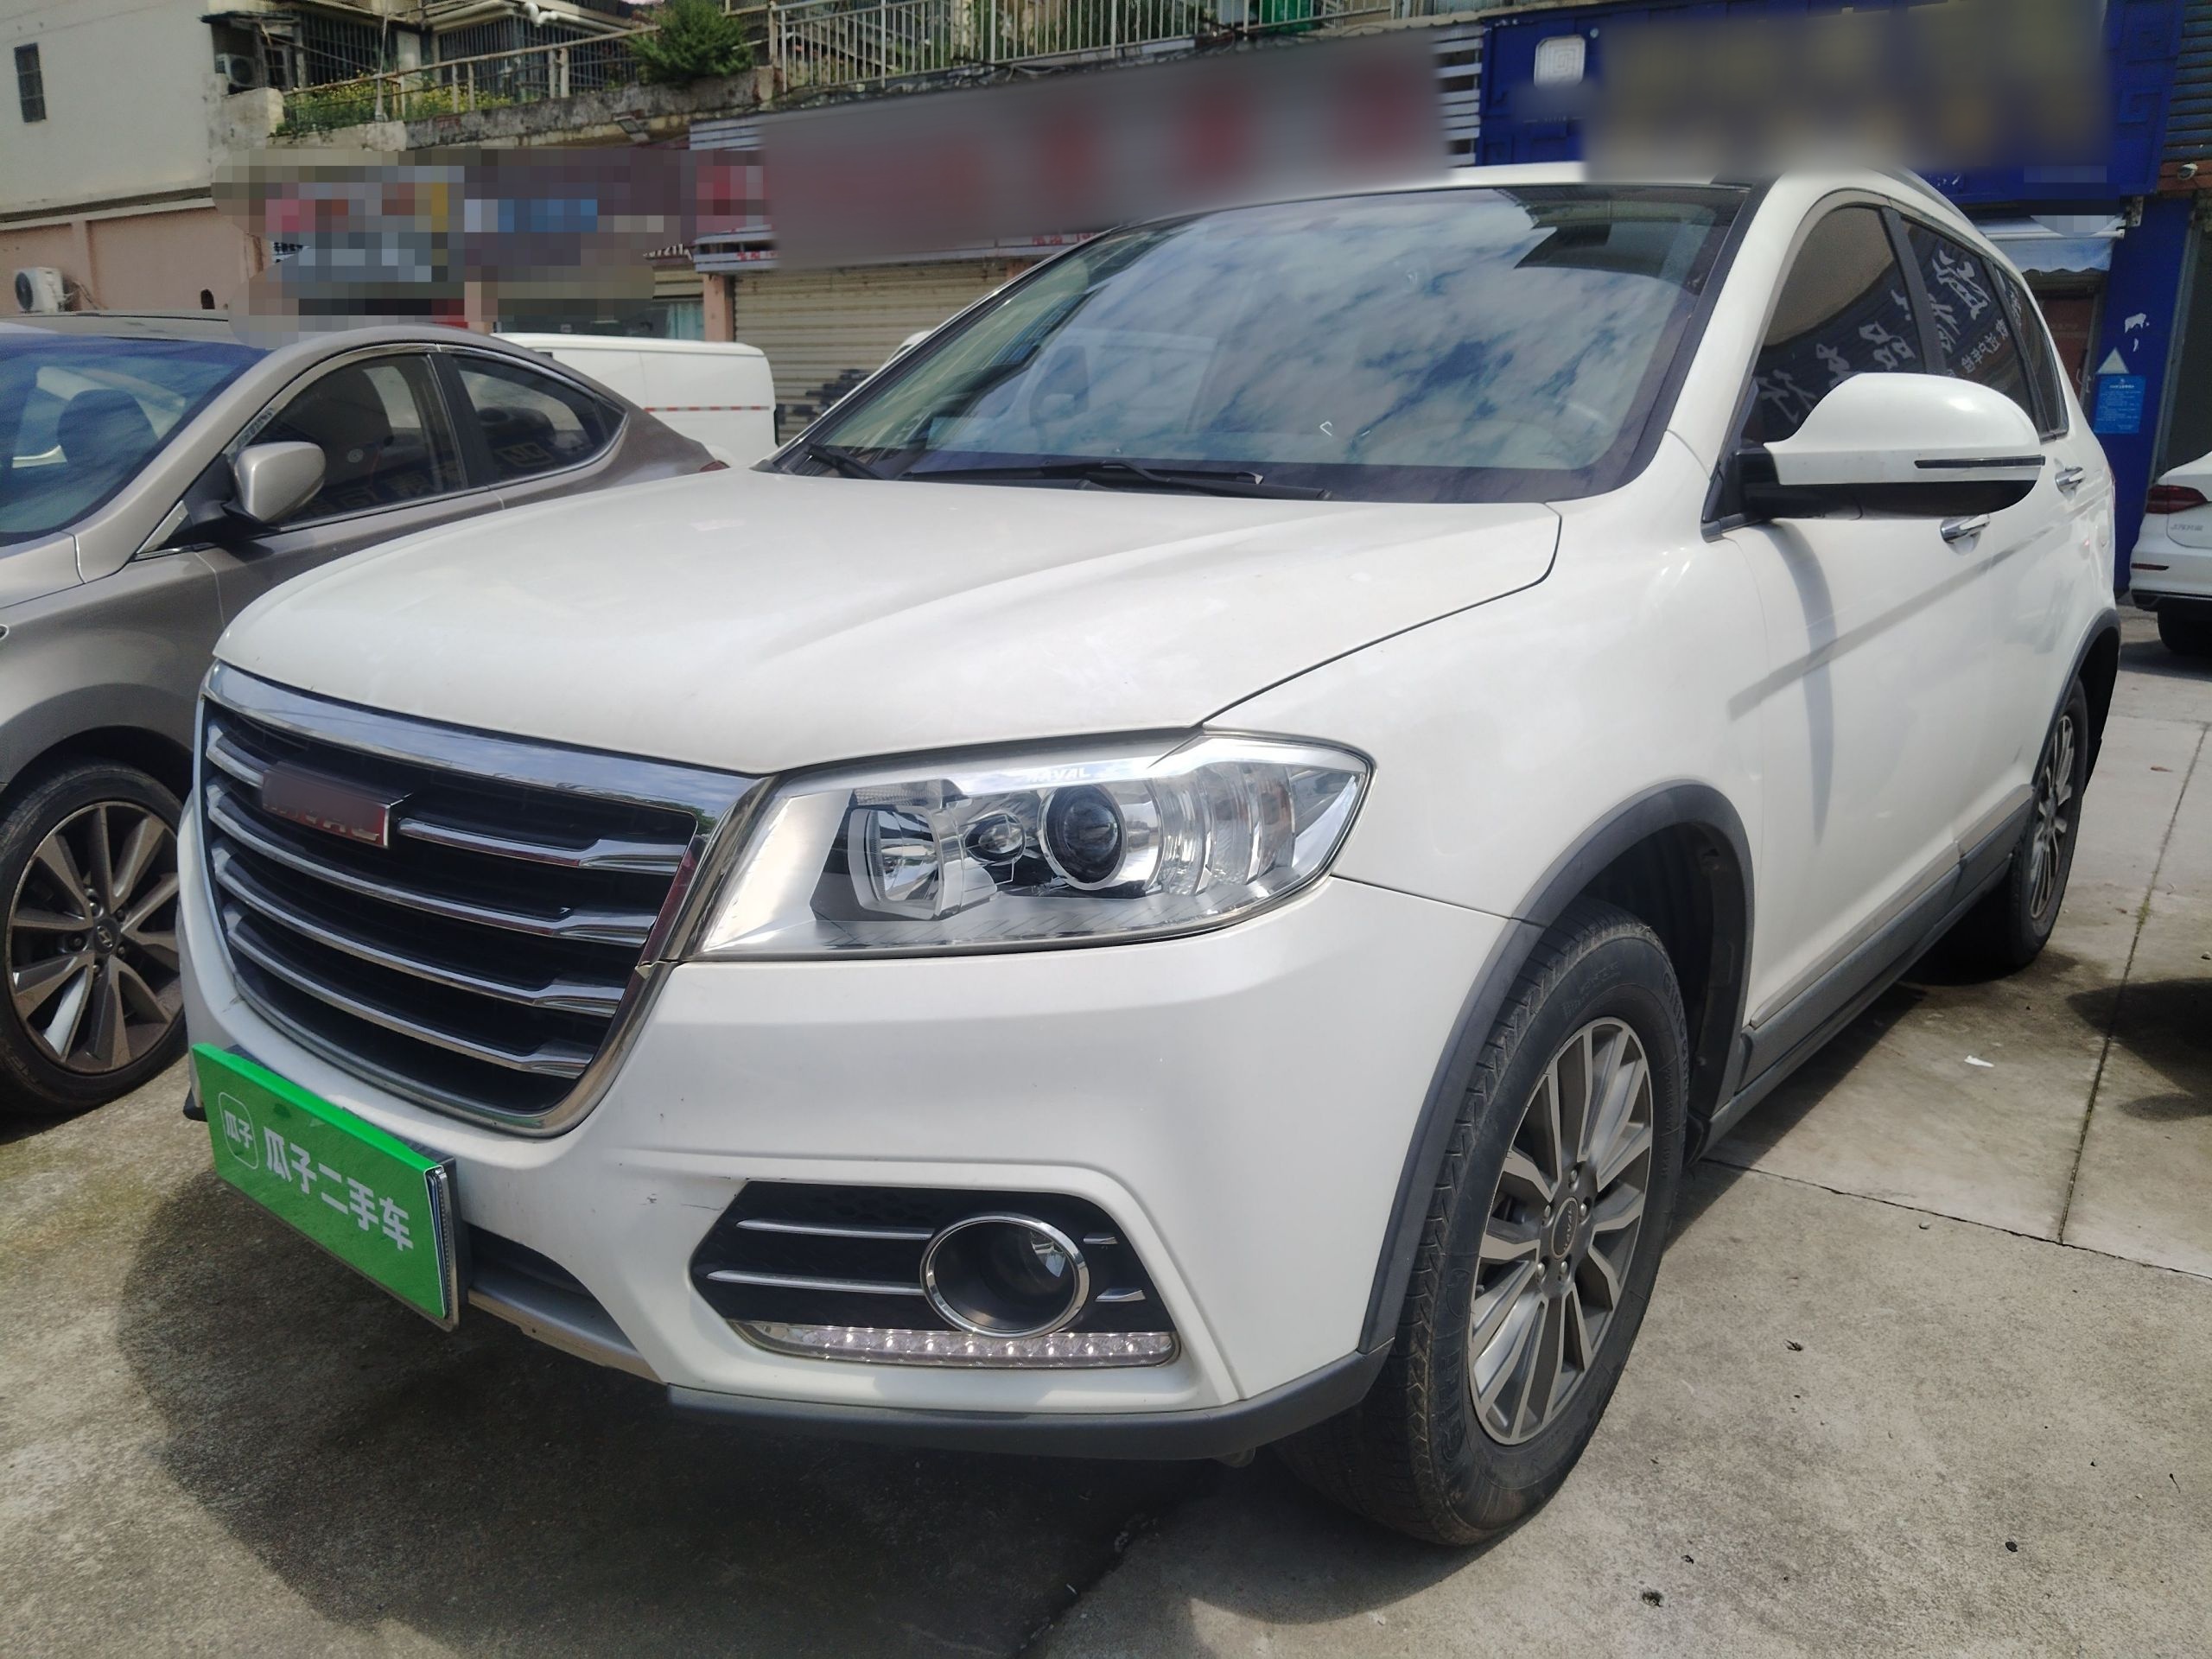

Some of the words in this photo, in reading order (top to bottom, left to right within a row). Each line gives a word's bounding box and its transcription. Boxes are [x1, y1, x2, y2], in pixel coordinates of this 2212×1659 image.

[224, 1109, 254, 1149] 瓜子
[263, 1126, 415, 1252] 瓜子二手车
